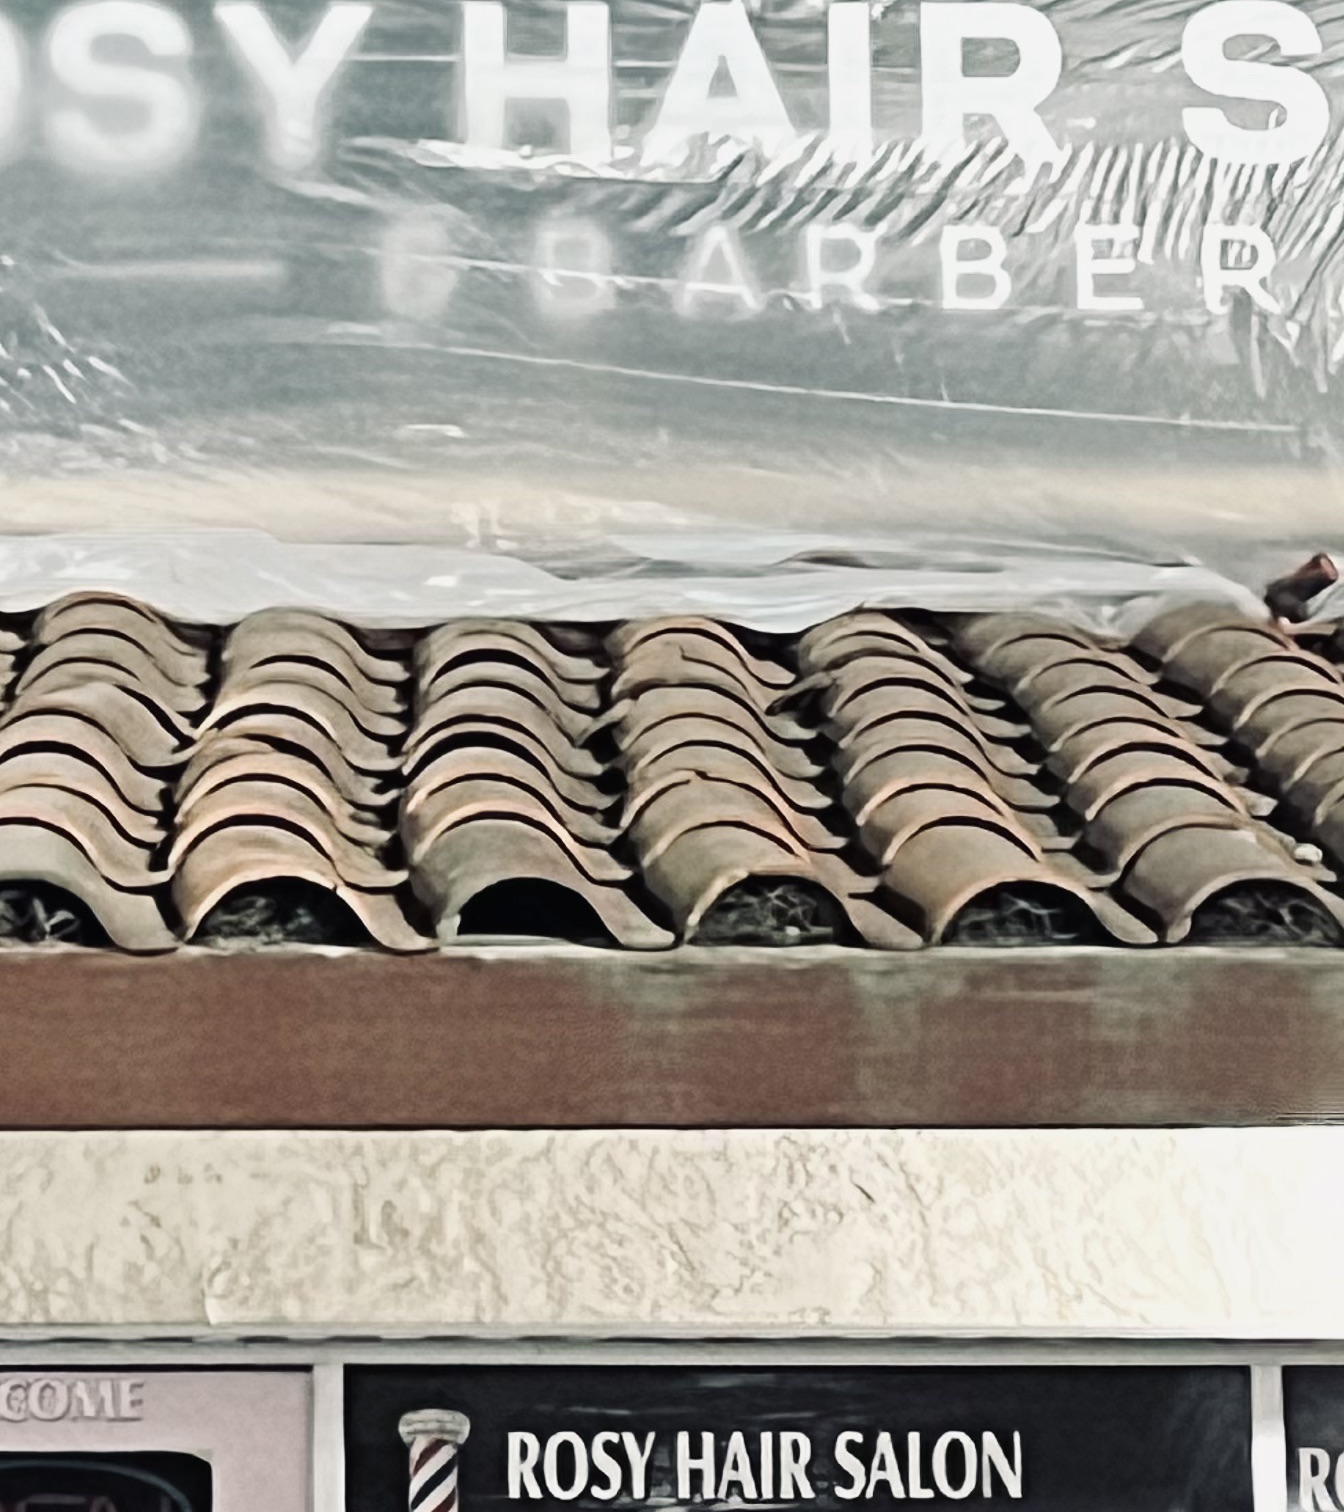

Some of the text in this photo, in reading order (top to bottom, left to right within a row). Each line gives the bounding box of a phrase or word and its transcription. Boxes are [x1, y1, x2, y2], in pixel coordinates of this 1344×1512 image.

[536, 221, 1286, 315] BARBER
[507, 1430, 1023, 1500] ROSY HAIR SALON
